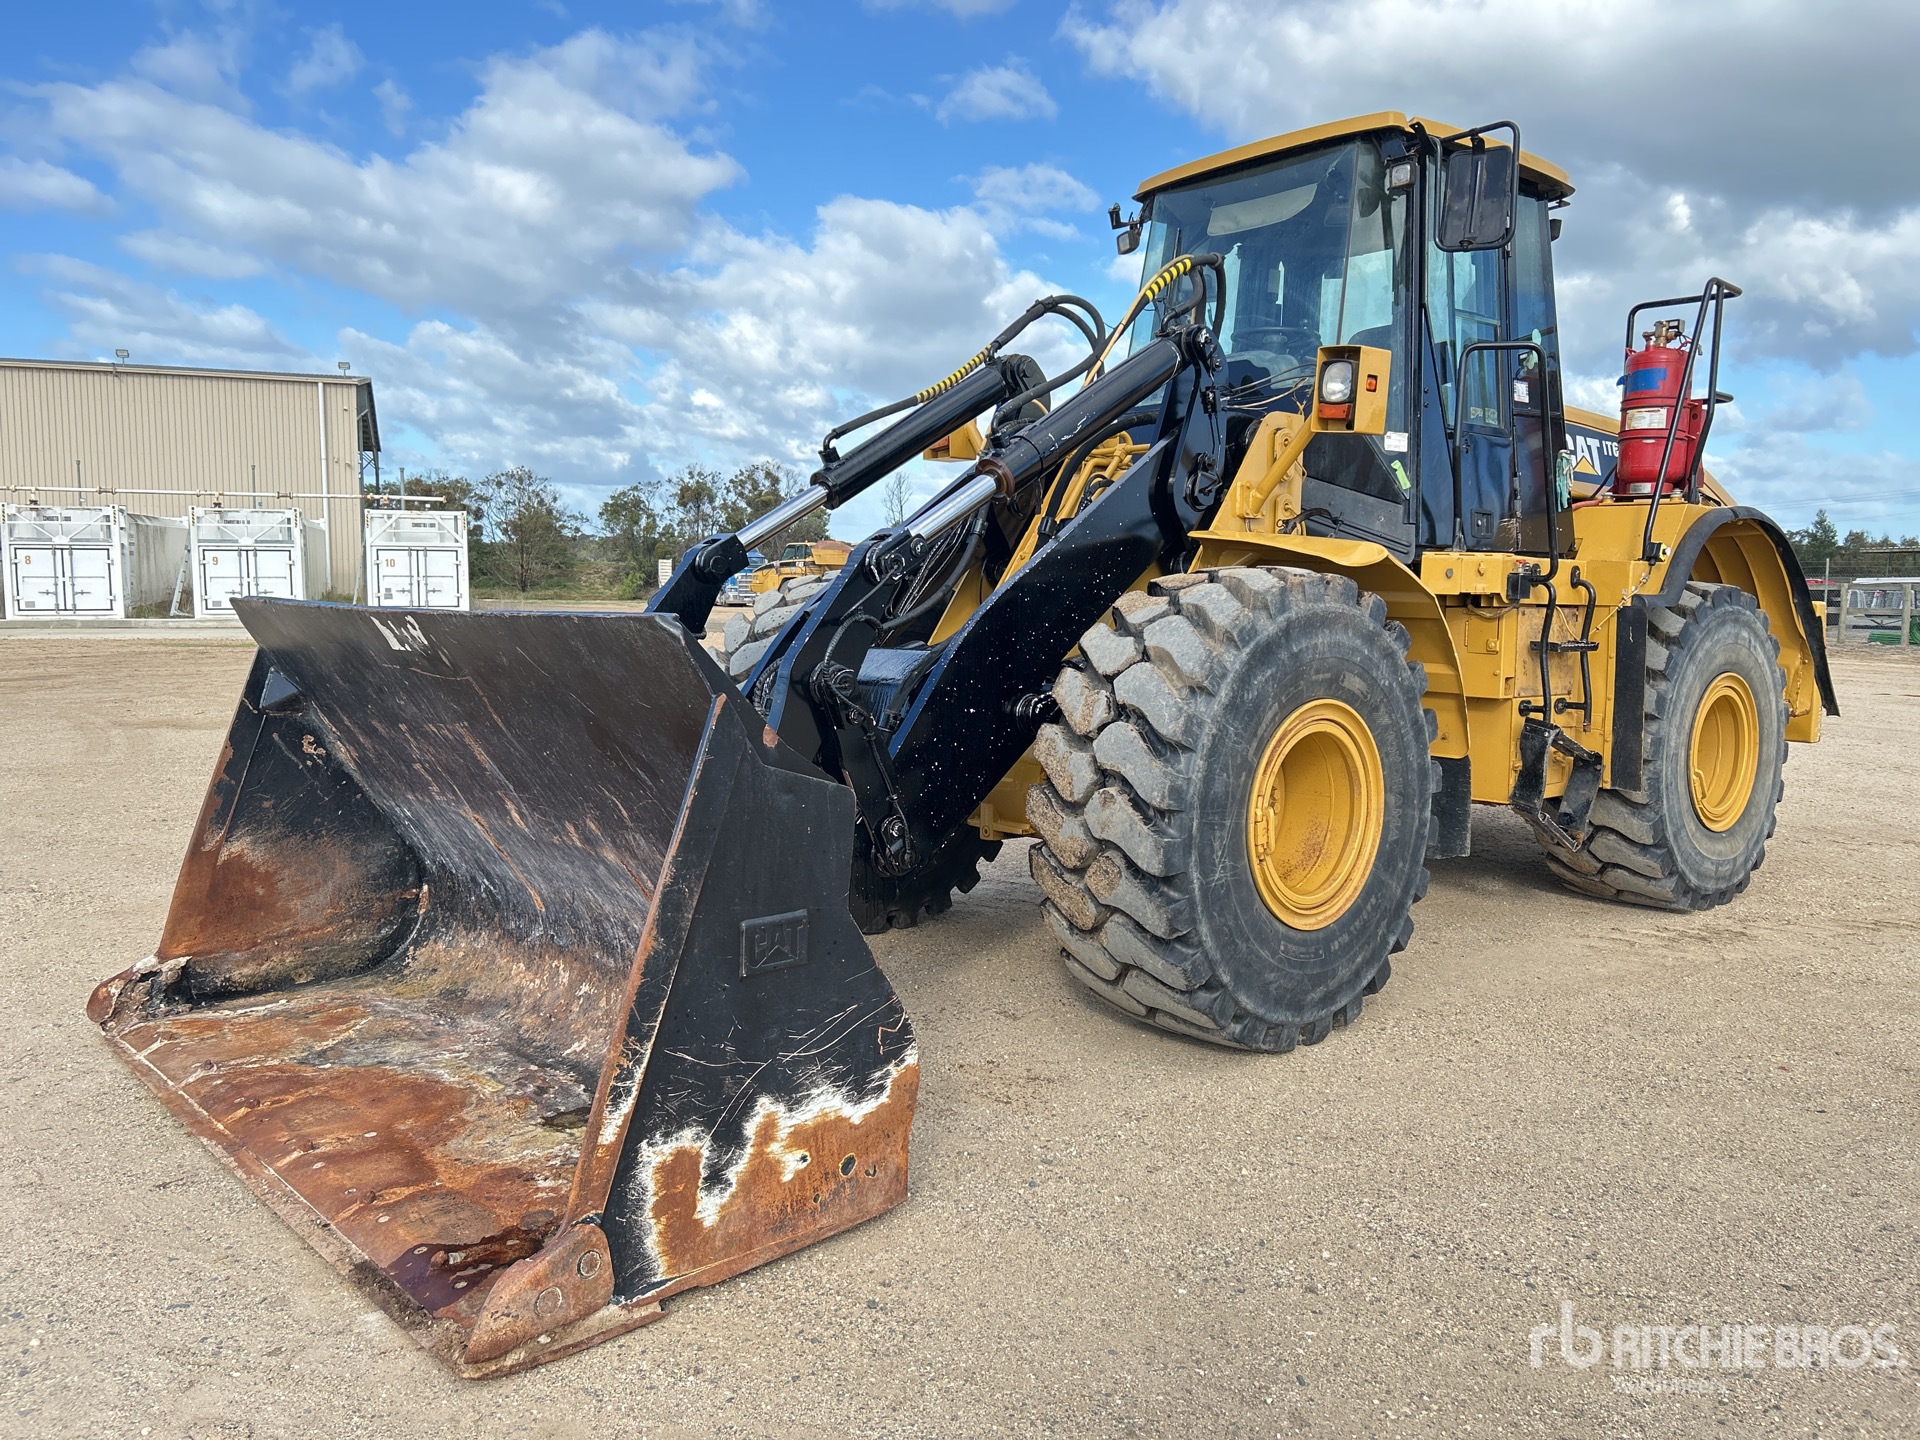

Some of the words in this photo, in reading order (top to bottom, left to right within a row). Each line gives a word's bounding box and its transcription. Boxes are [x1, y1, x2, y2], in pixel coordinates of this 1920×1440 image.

[24, 555, 32, 565] 8
[212, 556, 219, 566] 9
[385, 558, 396, 568] 10
